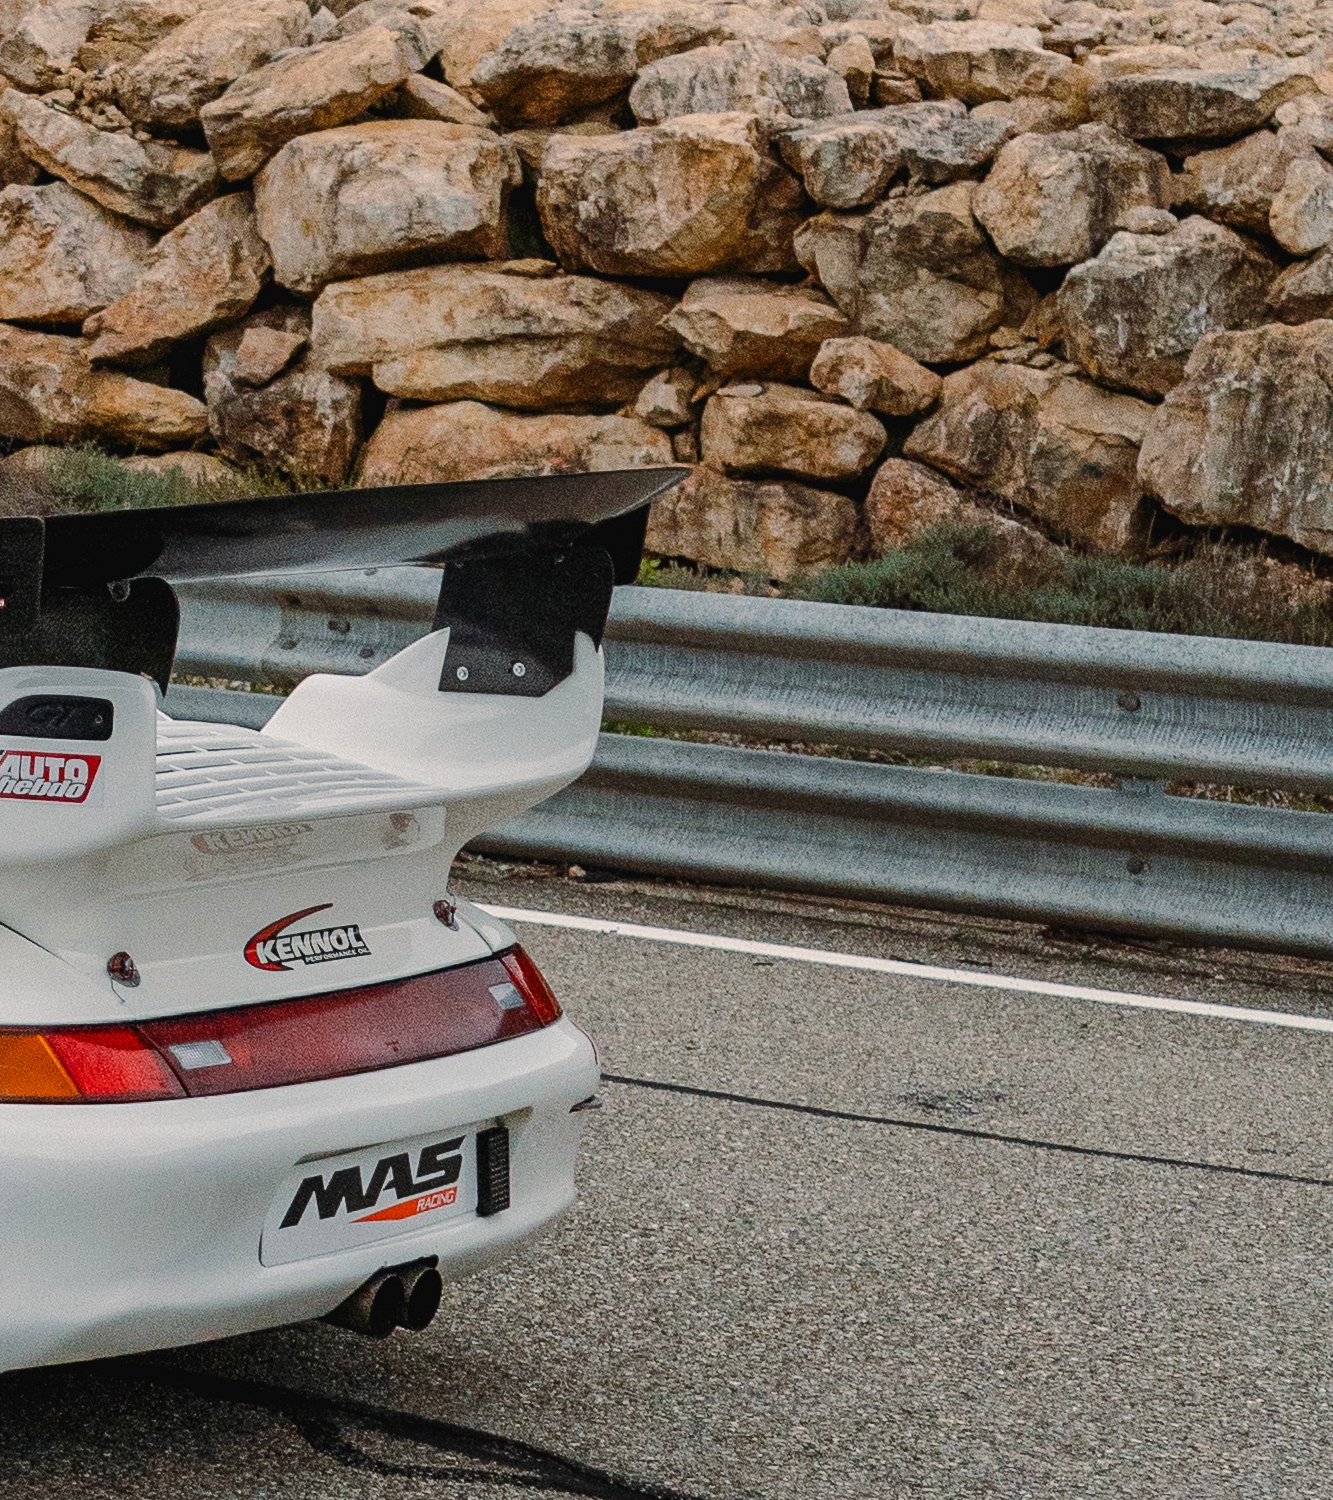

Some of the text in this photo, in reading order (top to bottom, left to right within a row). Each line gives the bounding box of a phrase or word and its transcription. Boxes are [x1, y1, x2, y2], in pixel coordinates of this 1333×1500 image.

[256, 927, 364, 964] KENNOL
[304, 949, 357, 963] PERFORMANCE
[278, 1134, 467, 1230] MAS
[416, 1189, 456, 1213] RACING
